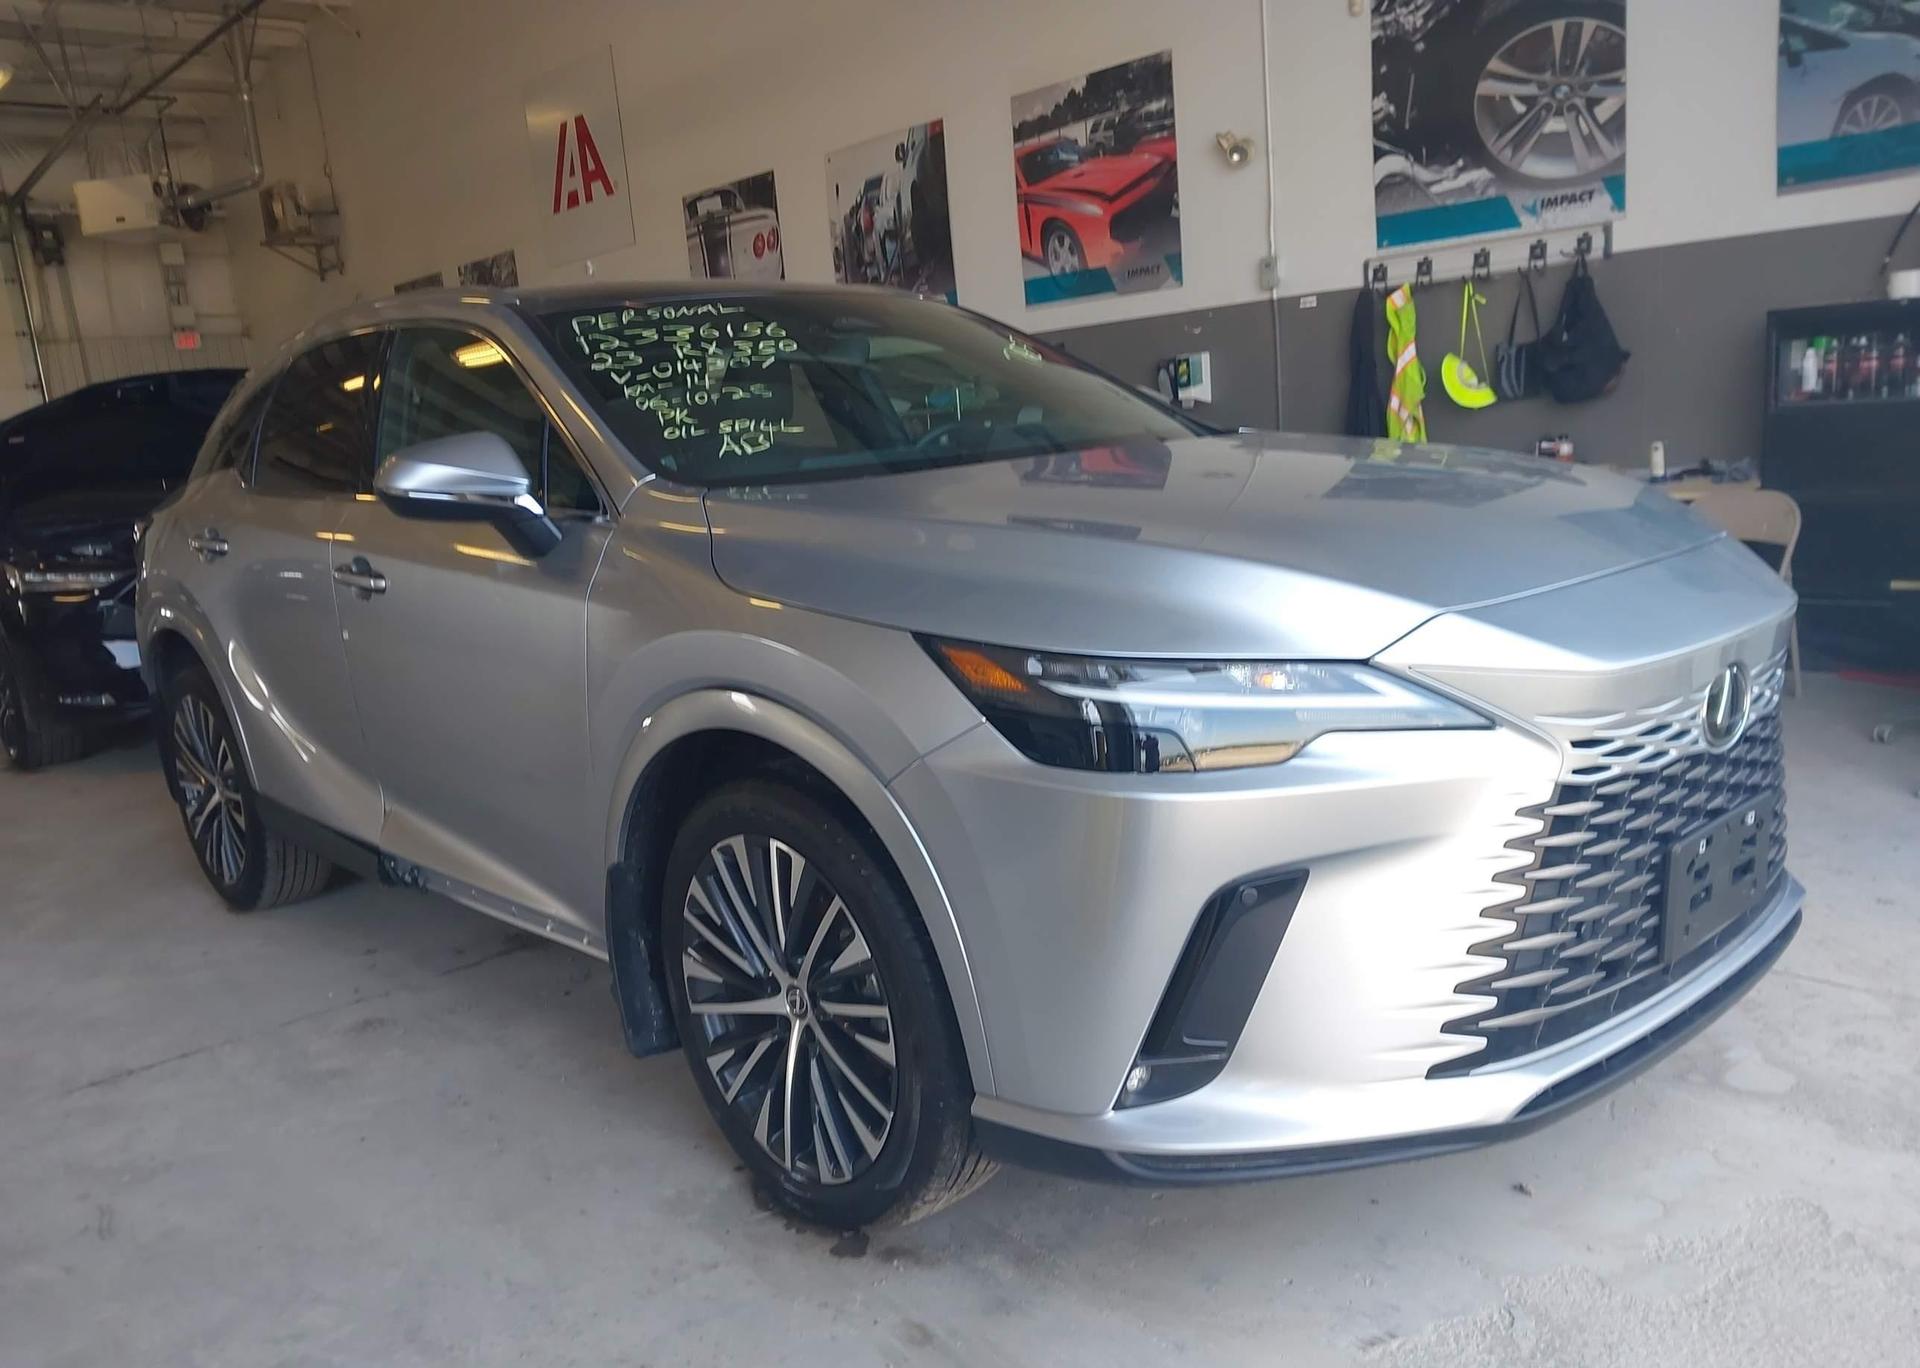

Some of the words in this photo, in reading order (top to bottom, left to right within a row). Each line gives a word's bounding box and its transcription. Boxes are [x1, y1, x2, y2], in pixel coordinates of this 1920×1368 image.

[1540, 188, 1595, 211] IMPACT
[571, 303, 745, 336] PERSONAL
[733, 338, 798, 357] 350
[663, 424, 708, 440] OIL
